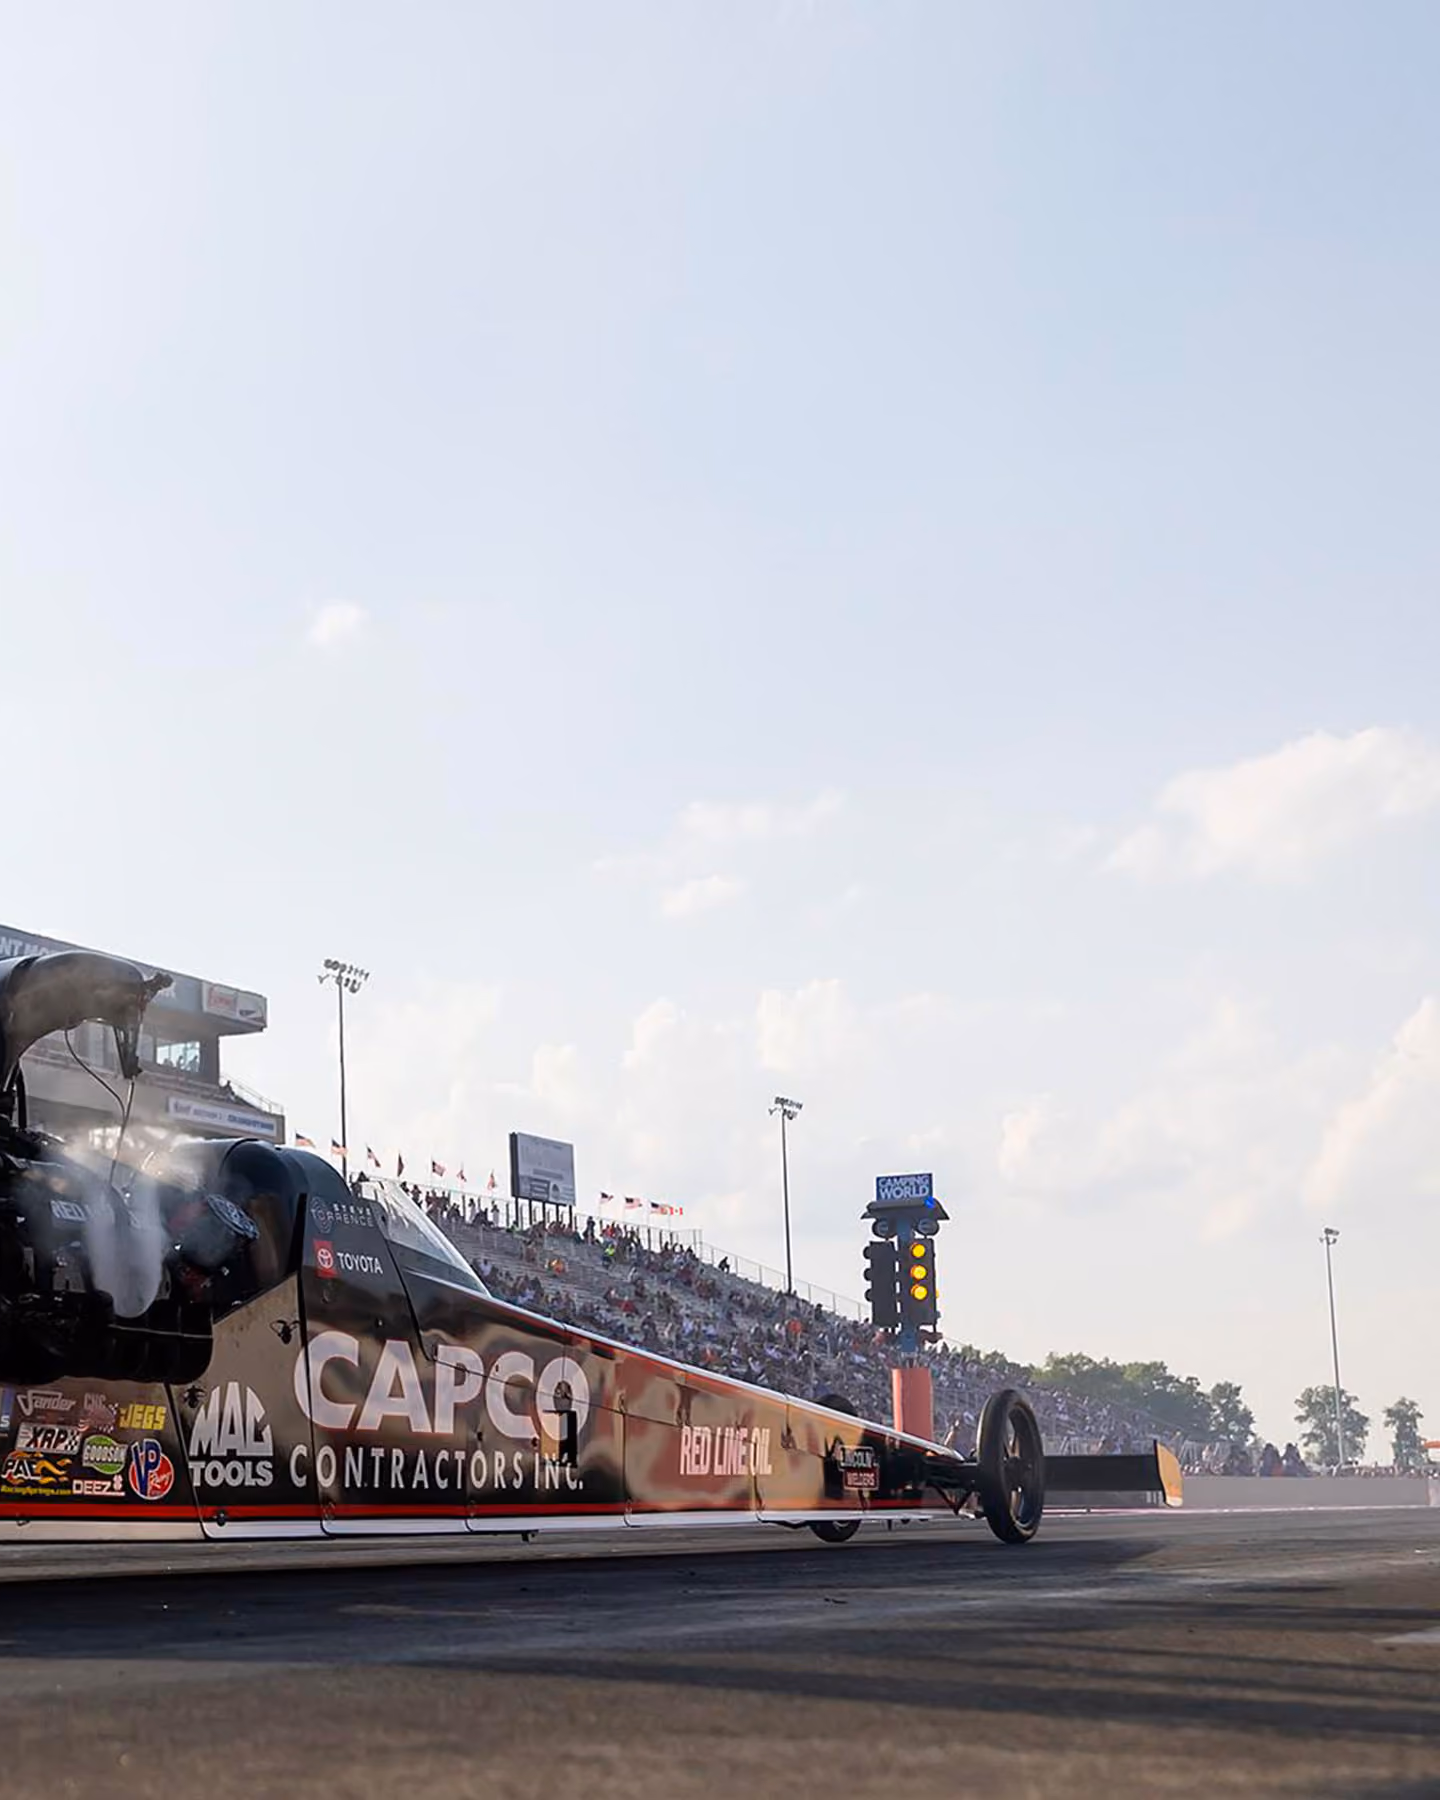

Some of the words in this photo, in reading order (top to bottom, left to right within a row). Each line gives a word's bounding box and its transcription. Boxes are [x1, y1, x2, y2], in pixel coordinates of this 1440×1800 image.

[877, 1174, 930, 1188] CAMPING
[878, 1185, 931, 1200] WORLD
[336, 1251, 384, 1275] TOYOTA
[293, 1331, 590, 1441] CAPCO
[119, 1404, 167, 1430] JEGS
[188, 1381, 274, 1457] MAC
[679, 1426, 711, 1476] RED
[713, 1427, 749, 1476] LINE
[749, 1427, 773, 1476] OIL
[188, 1460, 274, 1488] TOOLS
[289, 1444, 524, 1489] CONTRACTORS
